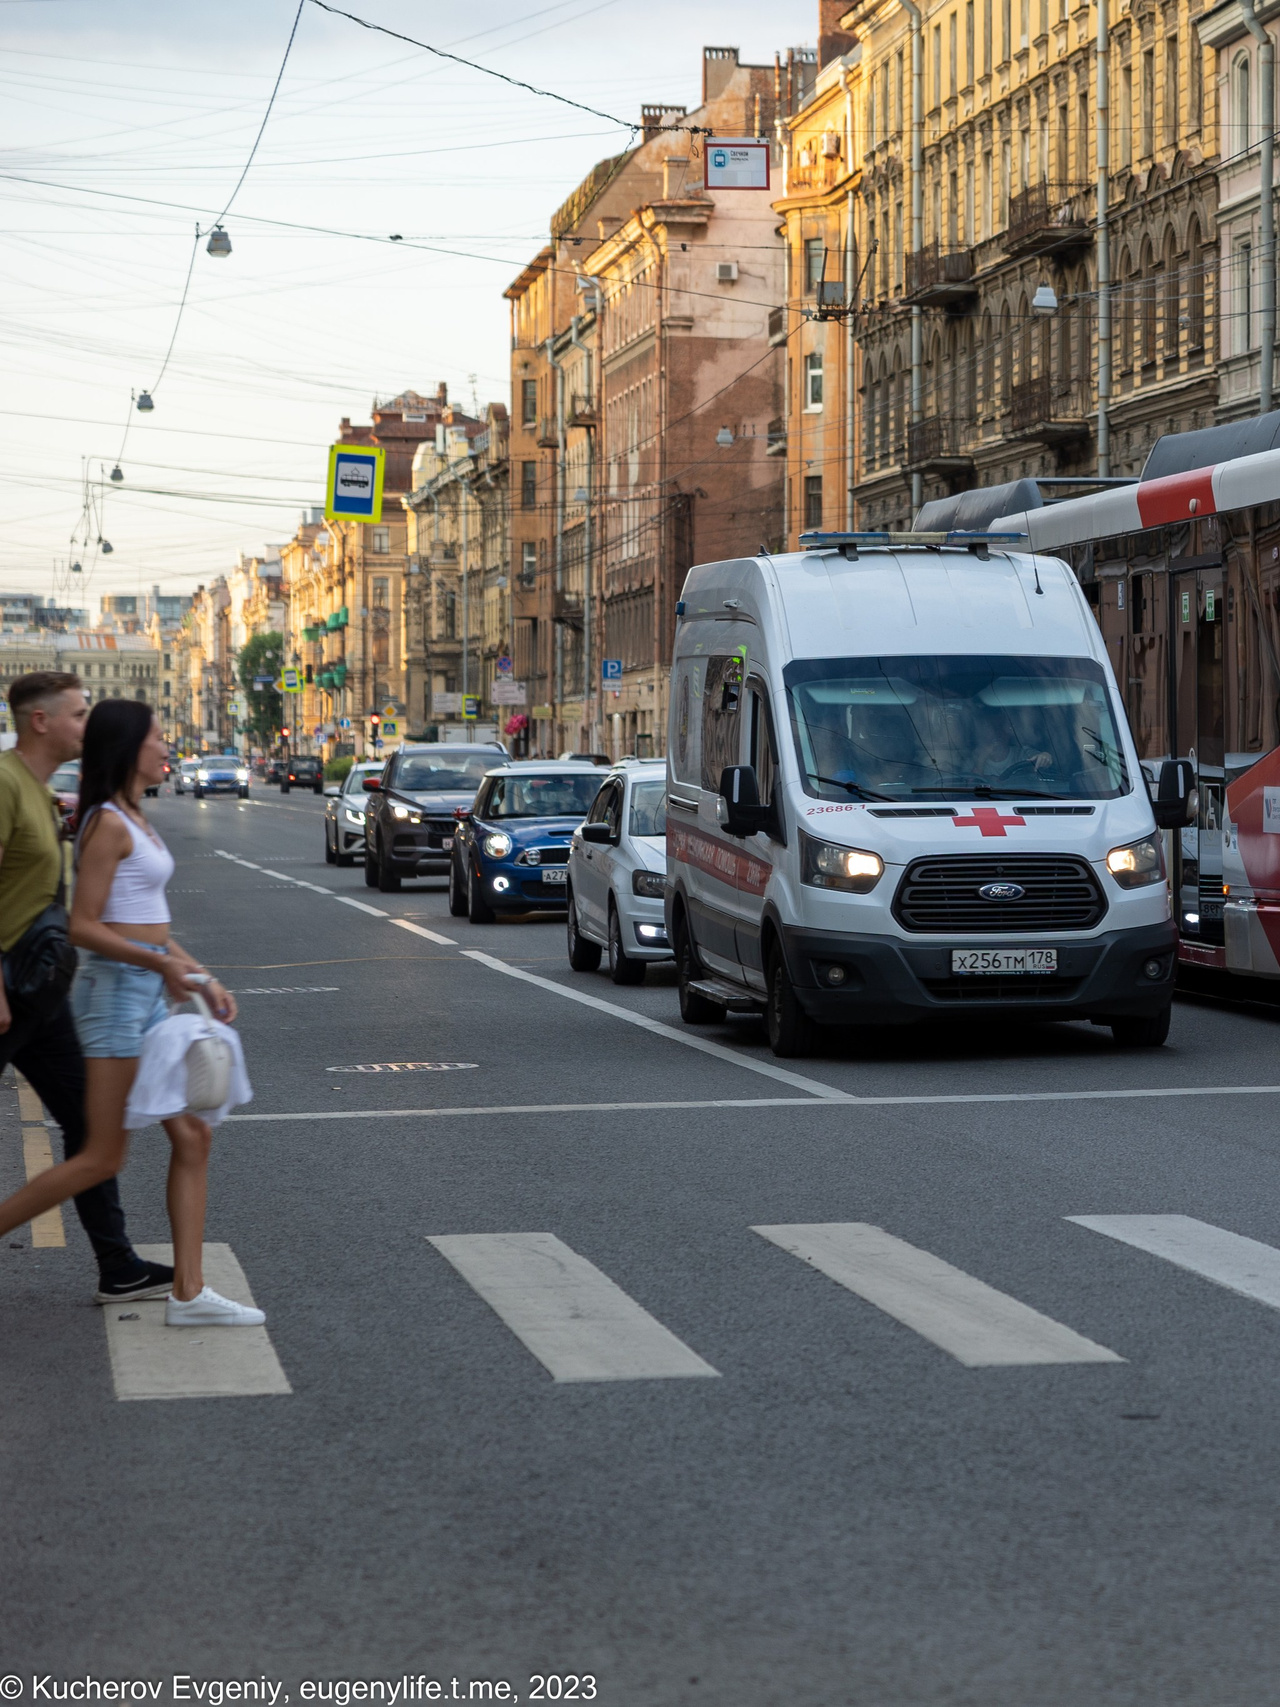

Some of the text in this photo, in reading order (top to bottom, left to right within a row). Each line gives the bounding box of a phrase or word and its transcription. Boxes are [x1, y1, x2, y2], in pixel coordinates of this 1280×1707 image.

[806, 804, 867, 816] 23686.1
[989, 885, 1015, 897] Ford
[1028, 951, 1053, 964] 178
